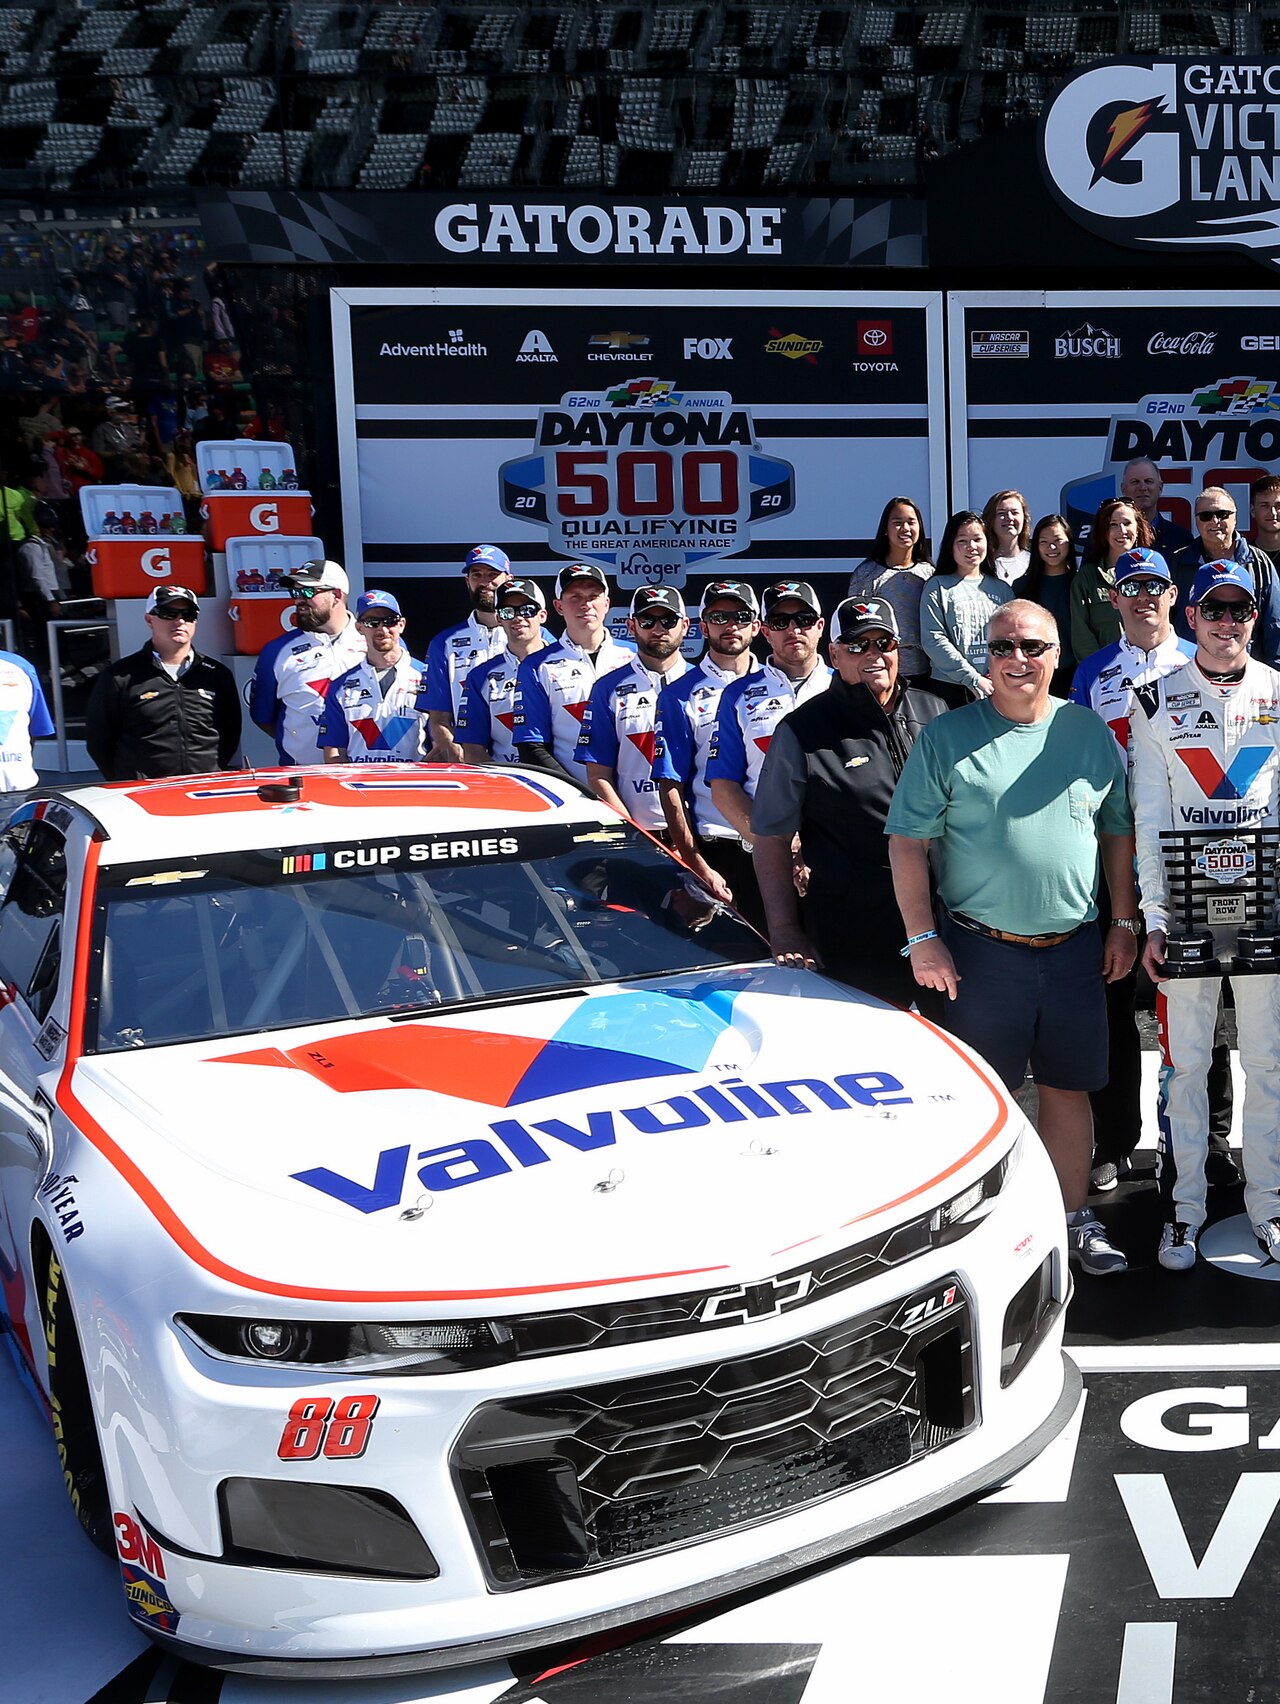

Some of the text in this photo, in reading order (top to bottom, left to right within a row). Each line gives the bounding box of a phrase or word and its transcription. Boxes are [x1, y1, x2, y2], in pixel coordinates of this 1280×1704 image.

[434, 204, 783, 255] GATORADE
[989, 333, 1020, 341] NASCAR
[379, 343, 488, 357] AdventHealth
[683, 337, 734, 360] FOX
[766, 339, 822, 353] SUNOCO
[995, 344, 1022, 352] SERIES
[1055, 337, 1121, 358] BUSCH
[515, 353, 559, 363] AXALTA
[587, 352, 654, 361] CHEVROLET
[852, 362, 899, 372] TOYOTA
[567, 396, 600, 408] 62ND
[684, 398, 725, 407] ANNUAL
[1146, 401, 1185, 414] 62ND
[539, 411, 753, 446] DAYTONA
[555, 451, 739, 517] 500
[514, 496, 536, 508] 20
[760, 494, 781, 506] 20
[249, 503, 280, 532] G
[561, 519, 737, 537] QUALIFYING
[1078, 524, 1092, 539] 2
[564, 539, 733, 549] THE GREAT AMERICAN RACE
[141, 548, 172, 577] G
[620, 552, 681, 584] Kroger
[513, 715, 525, 723] RC8
[1180, 805, 1272, 824] Valvoline
[333, 836, 519, 869] CUP SERIES
[1205, 846, 1247, 855] DAYTONA
[1207, 854, 1244, 869] 500
[1212, 898, 1240, 907] FRONT
[1215, 906, 1237, 915] ROW
[290, 1069, 915, 1216] Valvoline
[900, 1286, 957, 1329] ZL1
[276, 1394, 381, 1462] 88
[112, 1511, 168, 1580] 3M
[126, 1584, 174, 1613] SUNOCO
